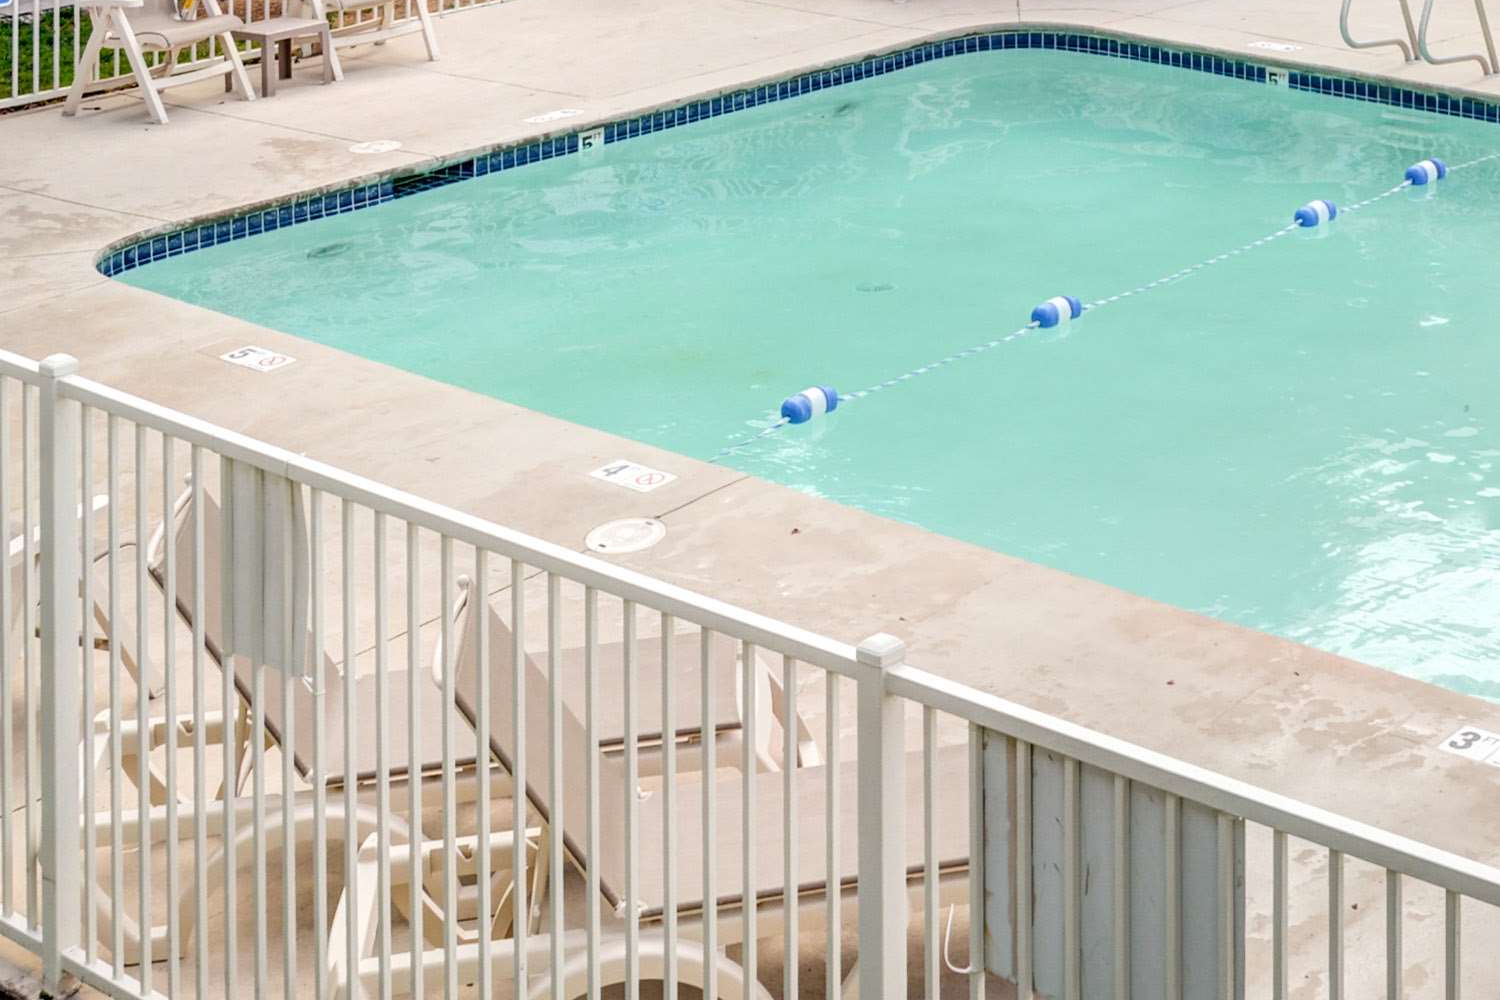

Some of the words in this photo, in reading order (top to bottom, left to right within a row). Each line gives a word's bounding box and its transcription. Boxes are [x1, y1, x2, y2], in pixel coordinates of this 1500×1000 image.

[1267, 72, 1278, 86] 5
[582, 135, 593, 149] 5
[1449, 731, 1481, 749] 3
[1482, 736, 1500, 745] FT
